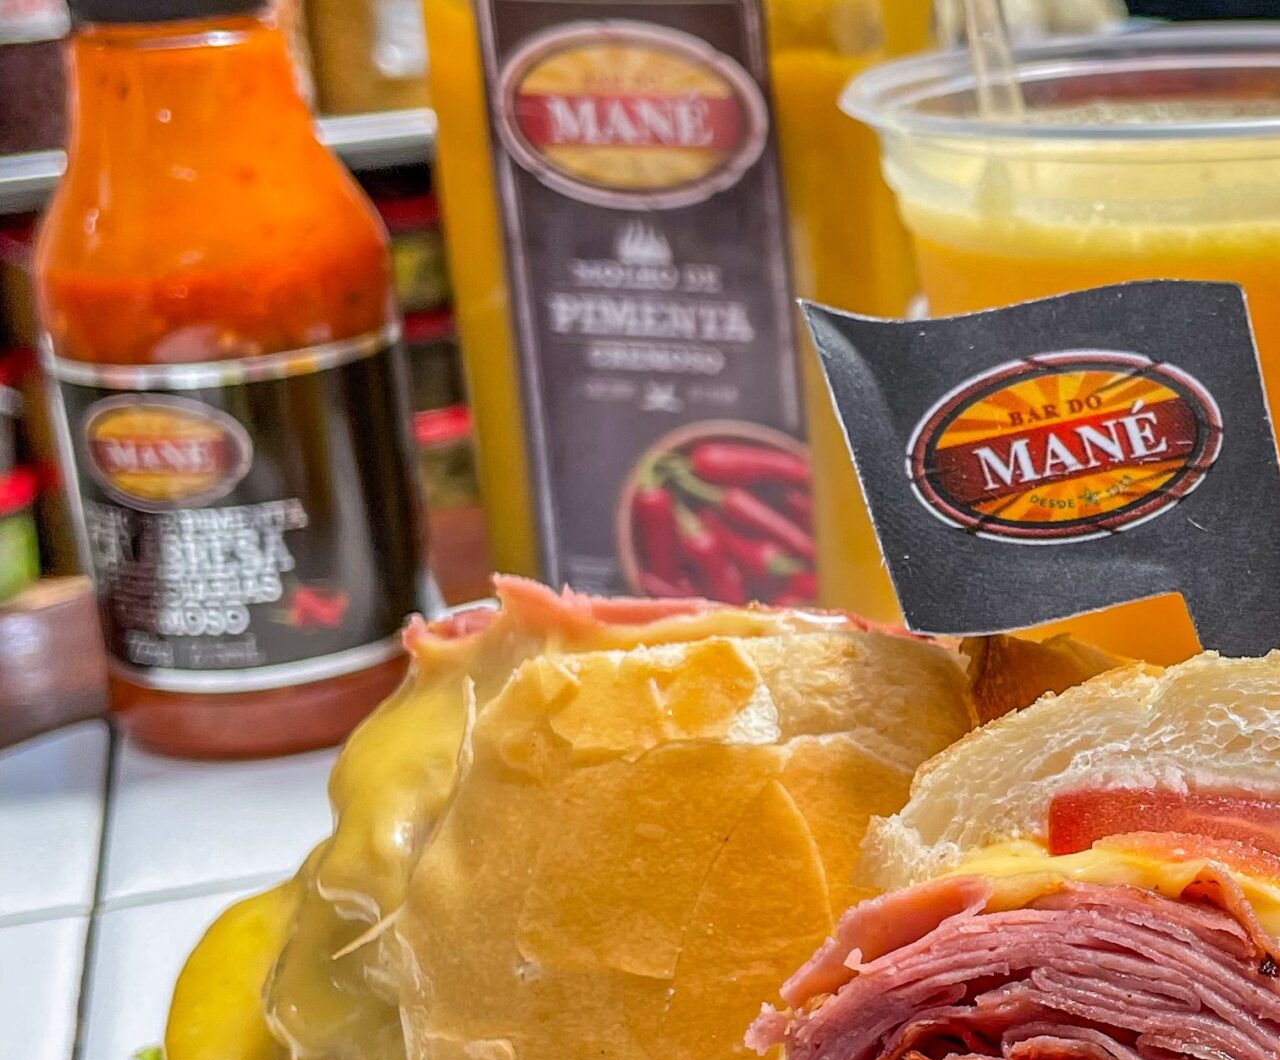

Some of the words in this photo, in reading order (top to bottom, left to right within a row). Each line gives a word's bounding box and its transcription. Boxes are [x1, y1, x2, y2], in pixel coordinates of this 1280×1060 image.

[546, 88, 714, 146] MANÉ
[548, 293, 754, 342] PIMENTA
[1008, 404, 1060, 426] BAR
[1069, 396, 1103, 414] DO
[973, 398, 1168, 491] MANÉ
[1030, 493, 1075, 510] DESDE
